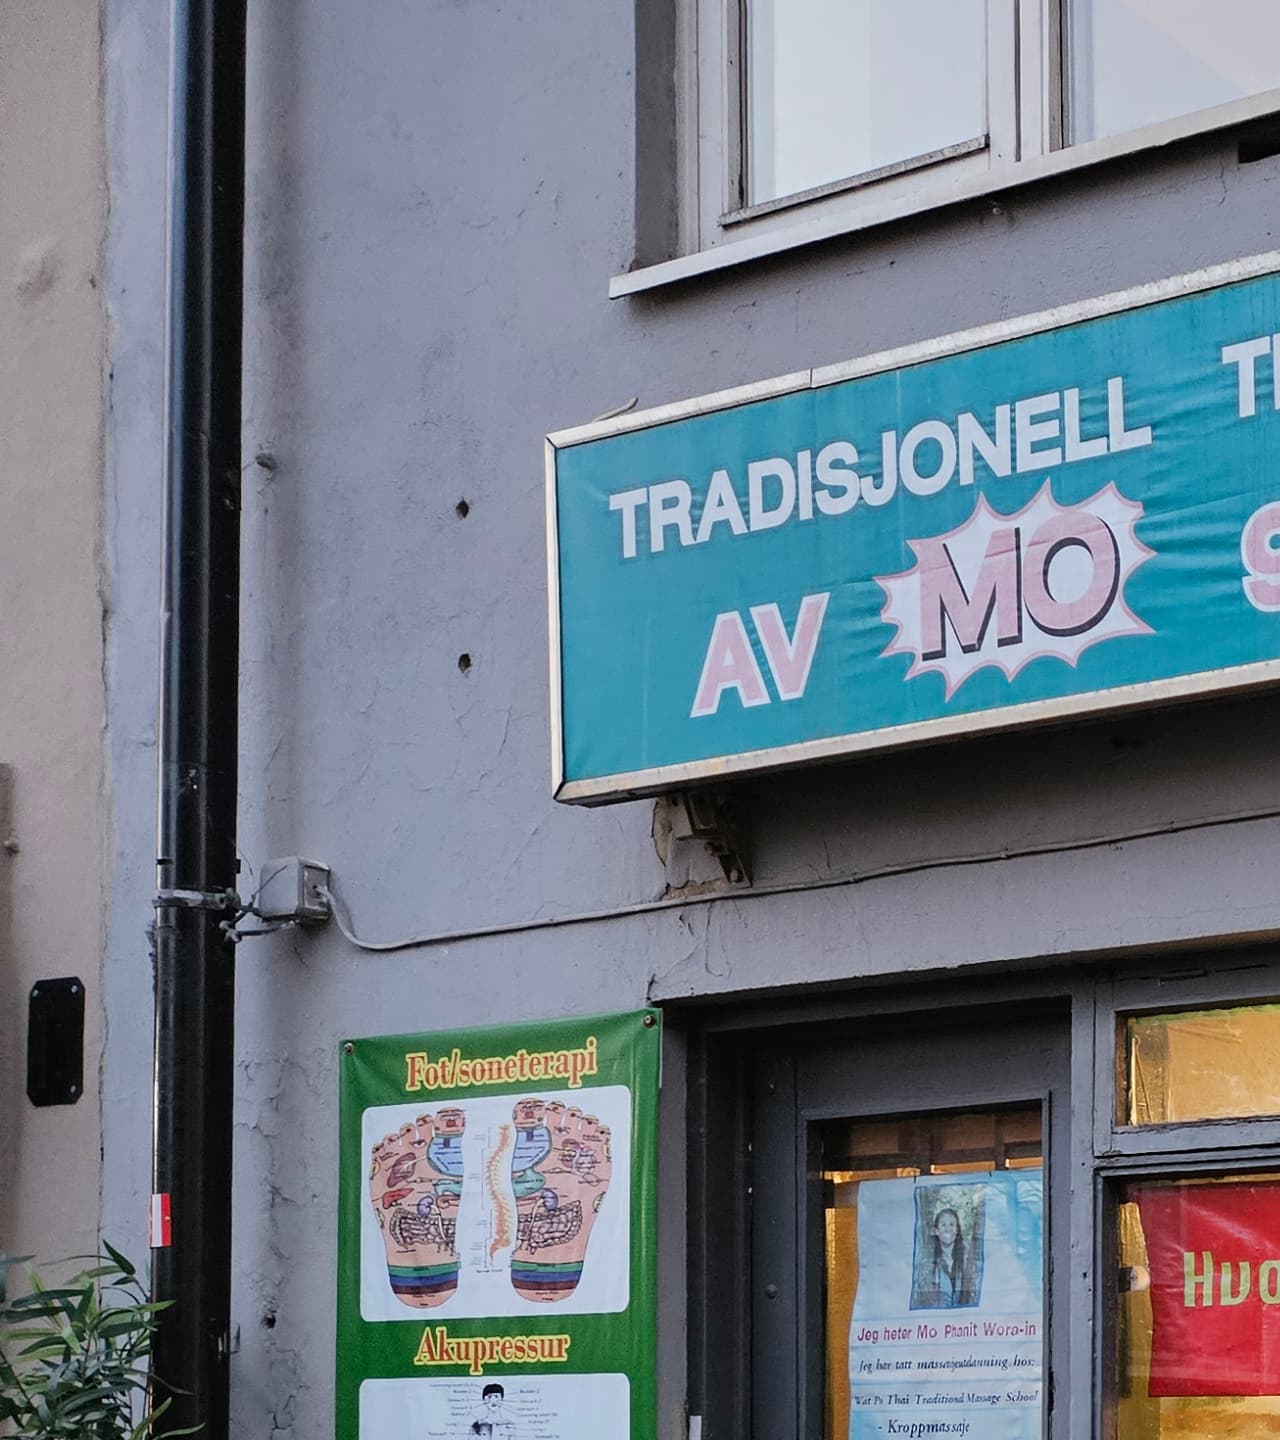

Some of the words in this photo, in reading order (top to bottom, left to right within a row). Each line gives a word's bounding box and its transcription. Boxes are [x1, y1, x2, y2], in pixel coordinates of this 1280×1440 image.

[609, 376, 1153, 559] TRADISJONELL
[689, 592, 830, 719] AV
[921, 512, 1120, 663] MO
[405, 1038, 597, 1093] Fot/soneterapi
[414, 1326, 570, 1375] Akupressur
[857, 1327, 879, 1344] Jeg
[883, 1326, 912, 1341] heter
[917, 1324, 937, 1339] Mo
[944, 1321, 978, 1338] Phanit
[983, 1320, 1036, 1336] Wora-in
[887, 1393, 909, 1405] Thai
[1006, 1390, 1039, 1402] School
